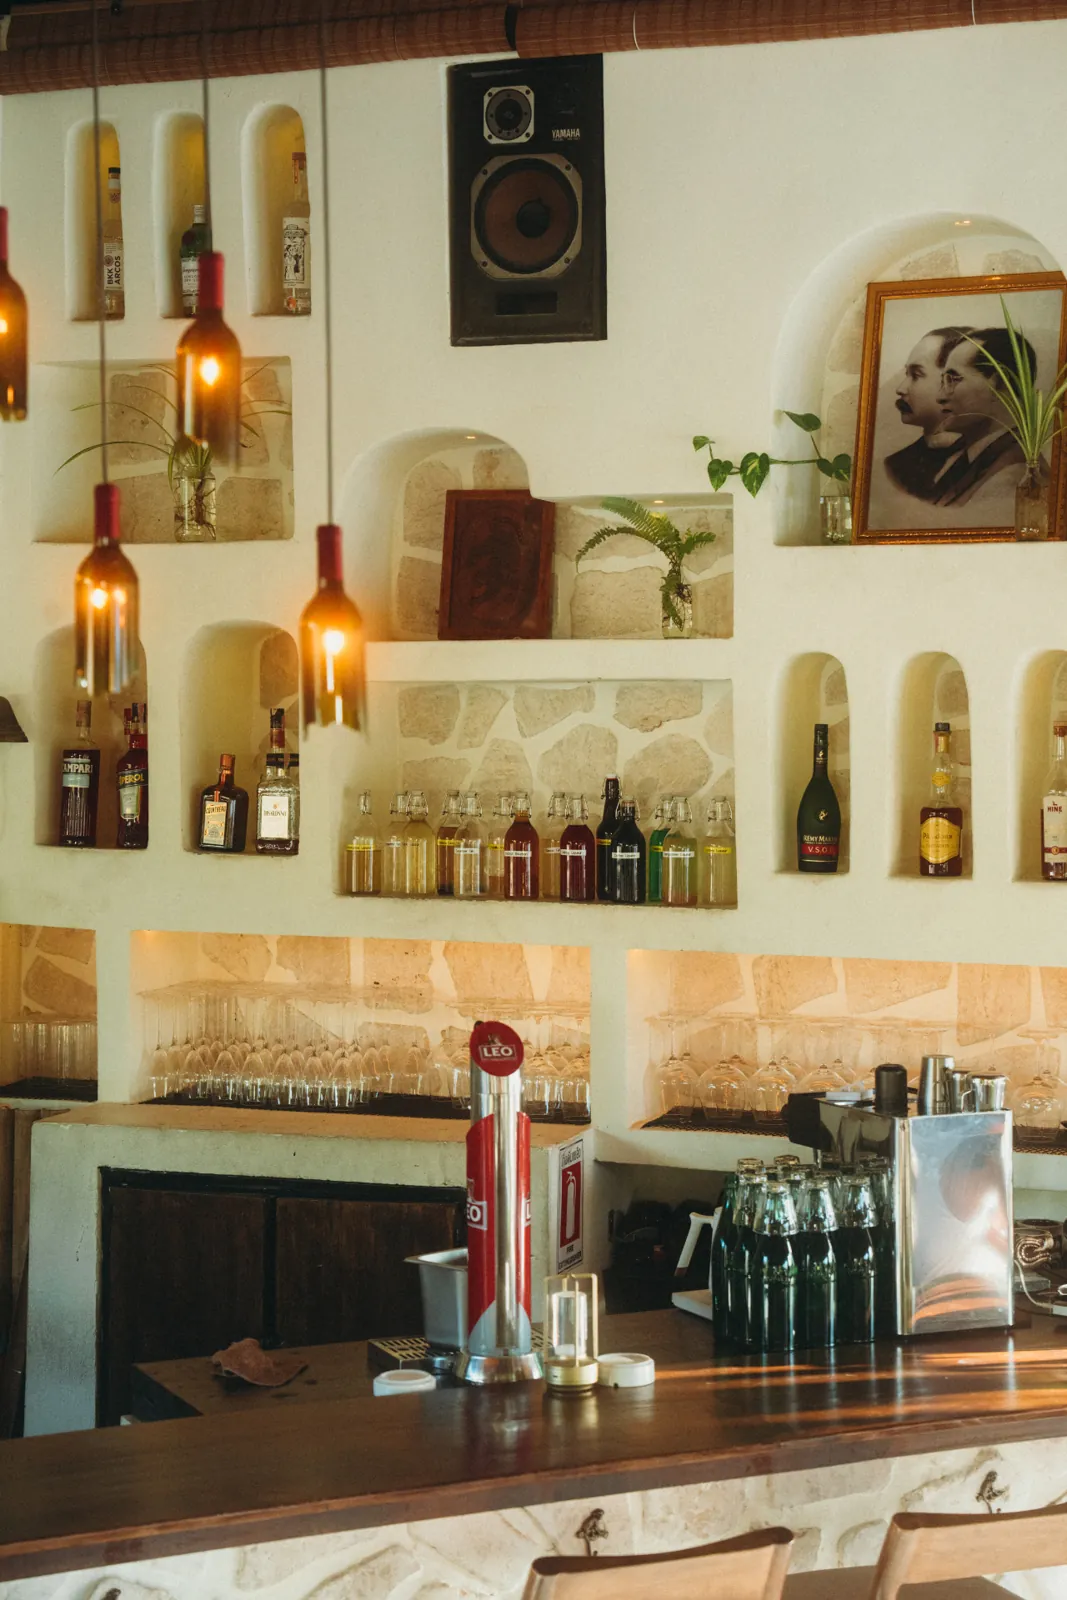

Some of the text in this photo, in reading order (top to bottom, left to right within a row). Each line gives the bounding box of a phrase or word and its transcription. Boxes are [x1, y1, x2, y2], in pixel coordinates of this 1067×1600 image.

[552, 128, 580, 139] YAMAHA
[63, 763, 93, 773] AMPARI
[483, 1046, 513, 1057] LEO
